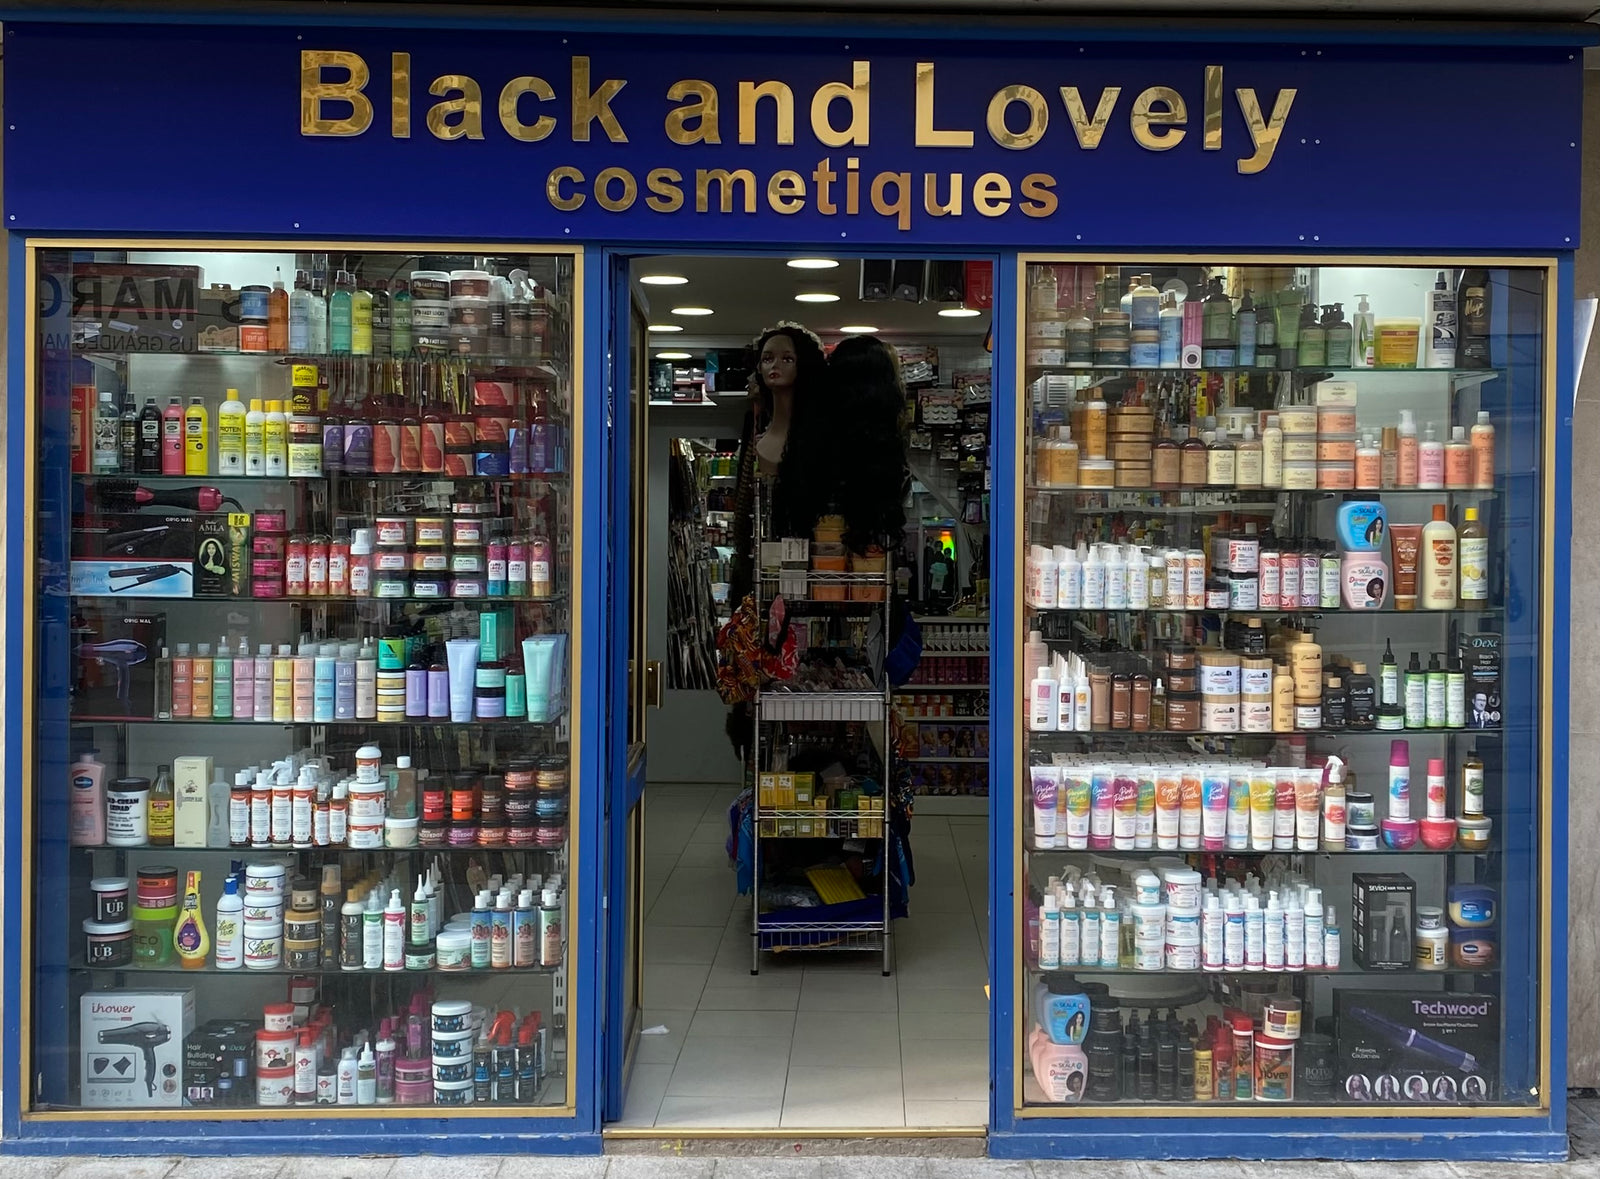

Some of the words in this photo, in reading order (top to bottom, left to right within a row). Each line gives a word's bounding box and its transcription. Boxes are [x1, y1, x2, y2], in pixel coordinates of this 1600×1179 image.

[301, 50, 629, 143] Black
[665, 61, 871, 147] and
[914, 63, 1298, 175] Lovely
[546, 157, 1059, 231] cosmetiques
[198, 524, 225, 532] AMLA
[1411, 1000, 1488, 1015] Techwood
